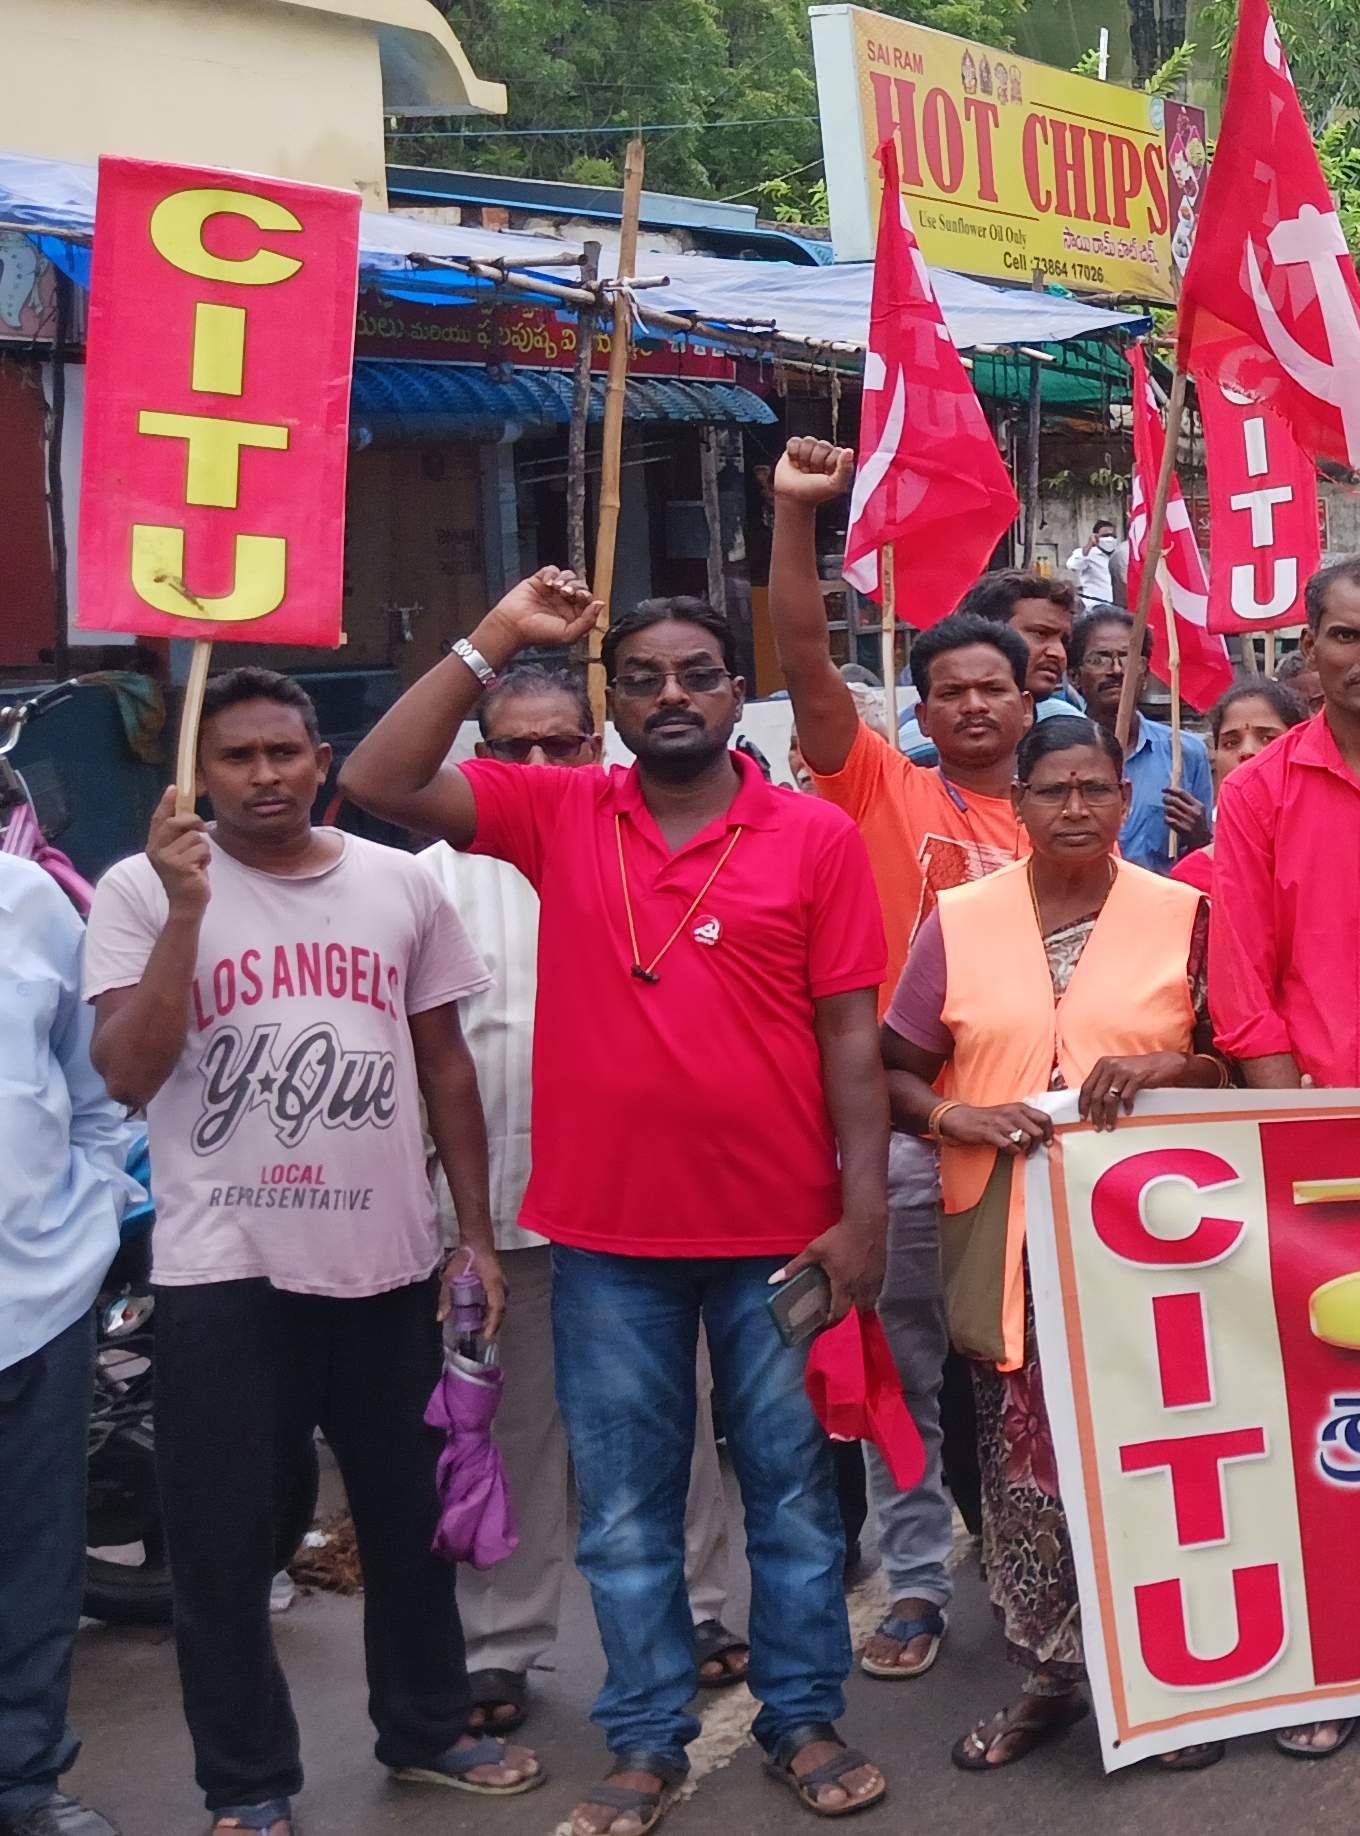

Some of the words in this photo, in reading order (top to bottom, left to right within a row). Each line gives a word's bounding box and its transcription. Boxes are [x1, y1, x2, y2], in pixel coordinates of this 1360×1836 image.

[867, 40, 890, 66] SAI
[894, 47, 924, 75] RAM
[870, 71, 999, 203] HOT
[1022, 113, 1169, 236] CHIPS
[919, 211, 936, 231] Use
[938, 212, 987, 242] Sunflower
[989, 219, 1004, 241] Oil
[1005, 223, 1027, 248] Only
[1003, 253, 1027, 271] Cell
[1072, 260, 1104, 283] 17026
[132, 189, 304, 621] CITU
[193, 949, 263, 1033] LOS
[260, 1164, 326, 1186] LOCAL
[209, 1186, 373, 1212] REPRESENTATIVE
[1091, 1147, 1290, 1690] CITU
